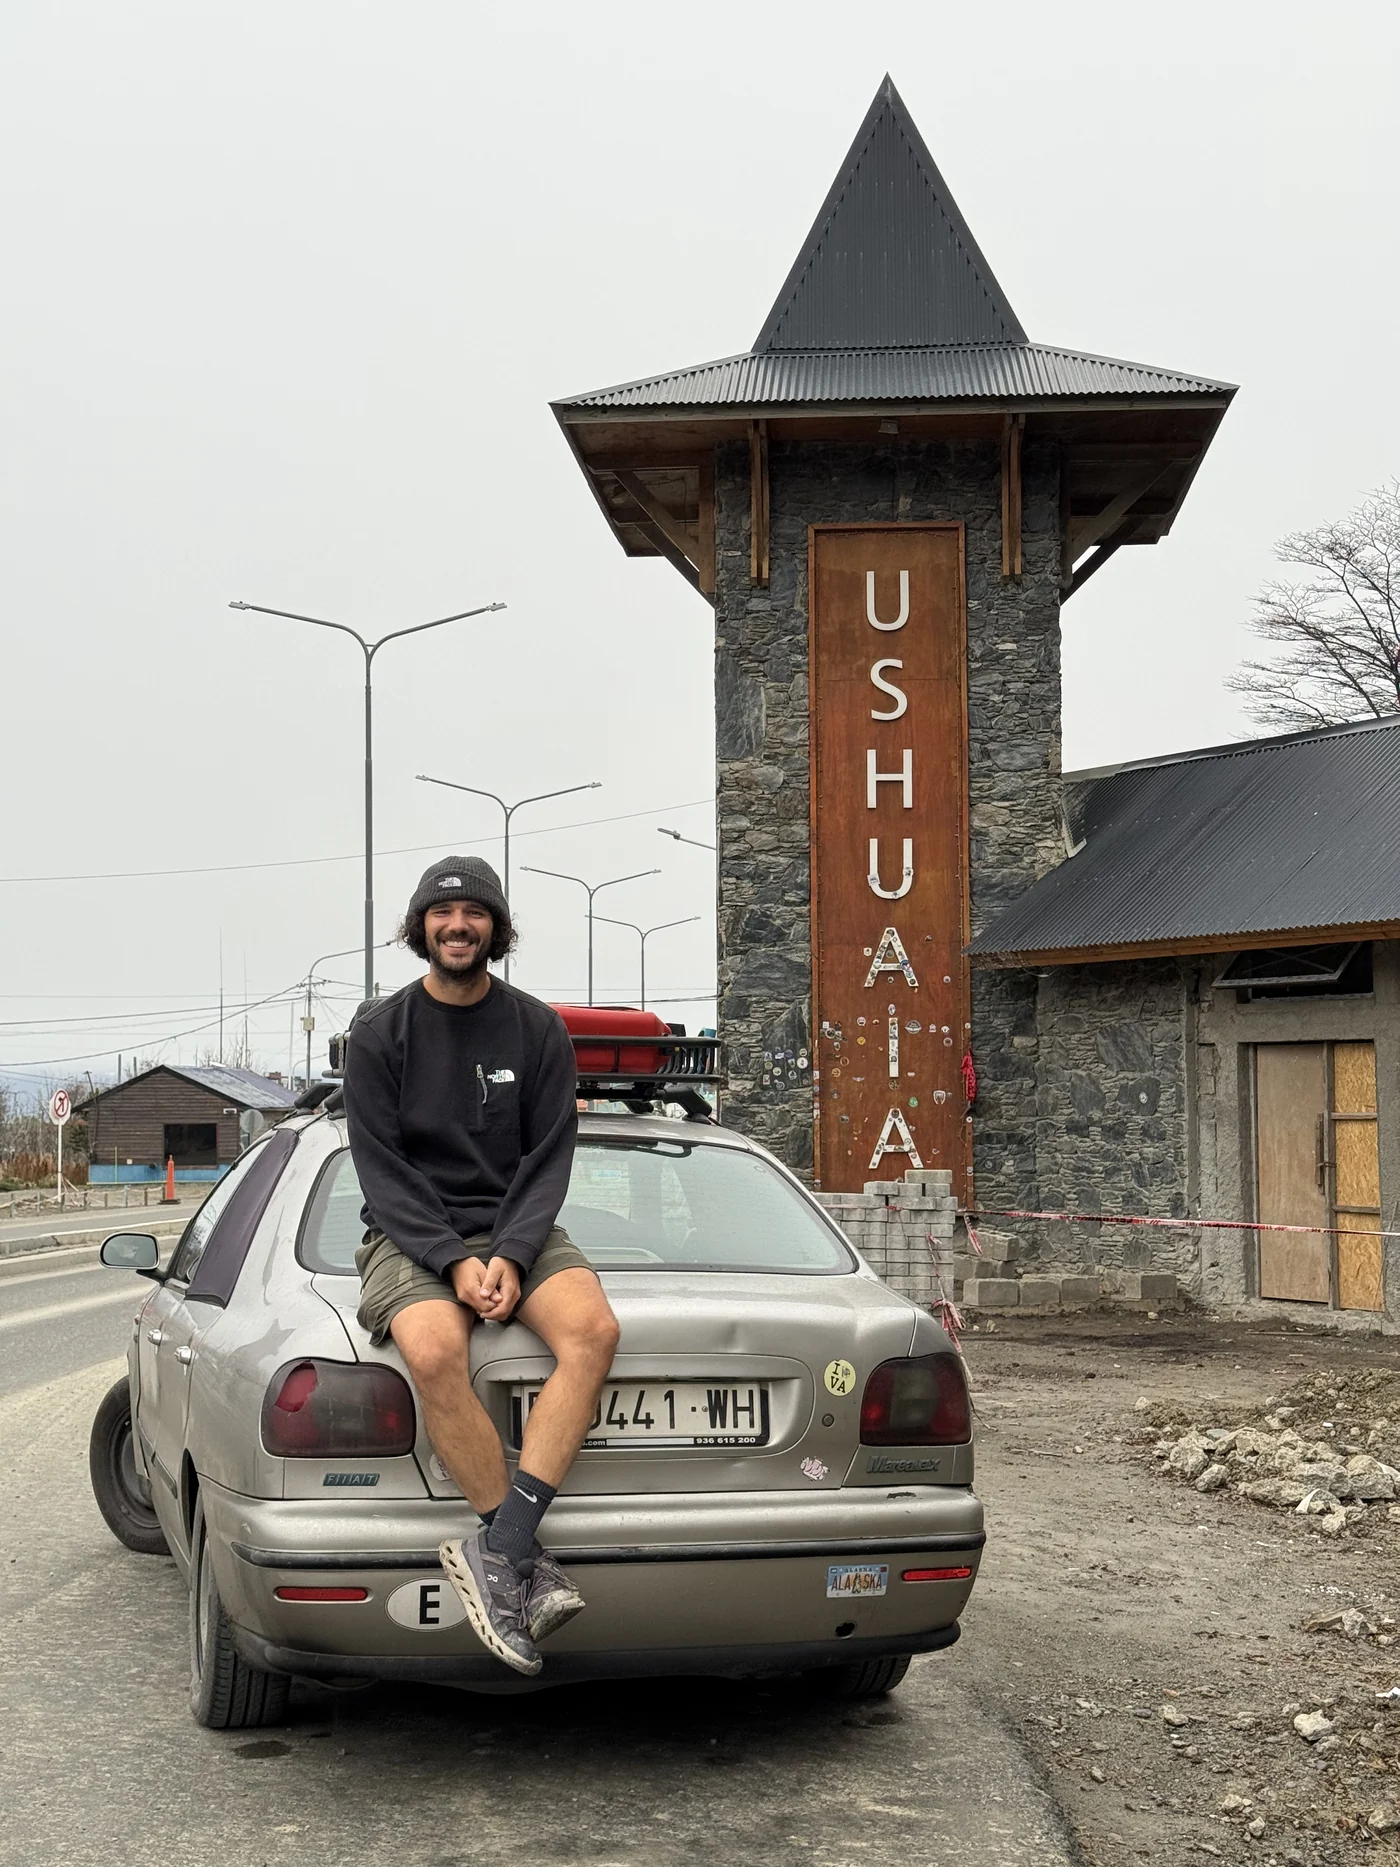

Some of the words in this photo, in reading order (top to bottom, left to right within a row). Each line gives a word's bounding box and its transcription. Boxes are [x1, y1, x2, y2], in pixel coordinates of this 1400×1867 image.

[864, 570, 924, 1169] USHUAIA
[833, 1363, 841, 1375] I
[831, 1376, 845, 1393] VA
[325, 1474, 376, 1485] FIAT
[419, 1585, 440, 1625] E
